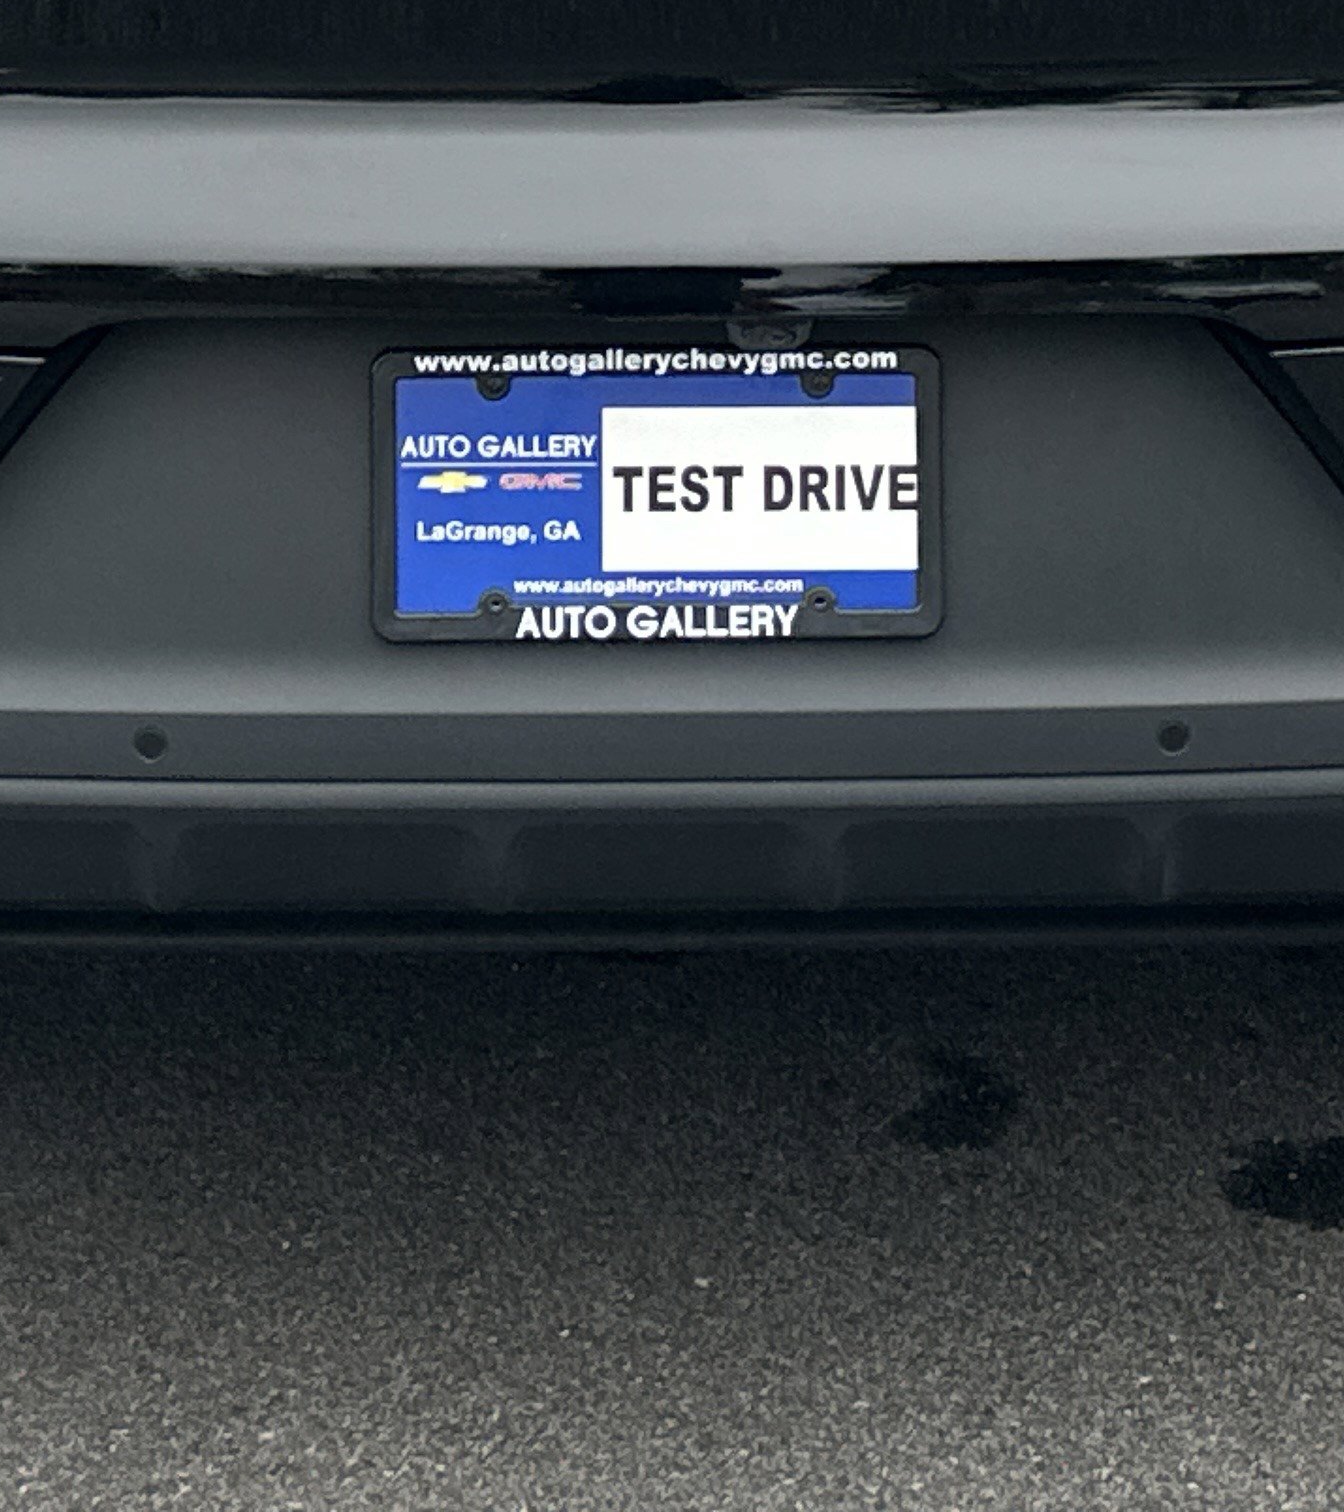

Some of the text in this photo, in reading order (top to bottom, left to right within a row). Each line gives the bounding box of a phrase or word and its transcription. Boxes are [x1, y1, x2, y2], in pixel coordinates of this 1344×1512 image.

[414, 348, 898, 375] www.autogallerychevygmc.com
[400, 434, 597, 459] AUTO GALLERY
[499, 473, 583, 491] GMC
[613, 465, 919, 512] TEST DRIVE
[416, 521, 581, 545] LaGrange, GA
[514, 577, 803, 596] www.autogallerychevygmc.com
[516, 605, 798, 639] AUTO GALLERY
